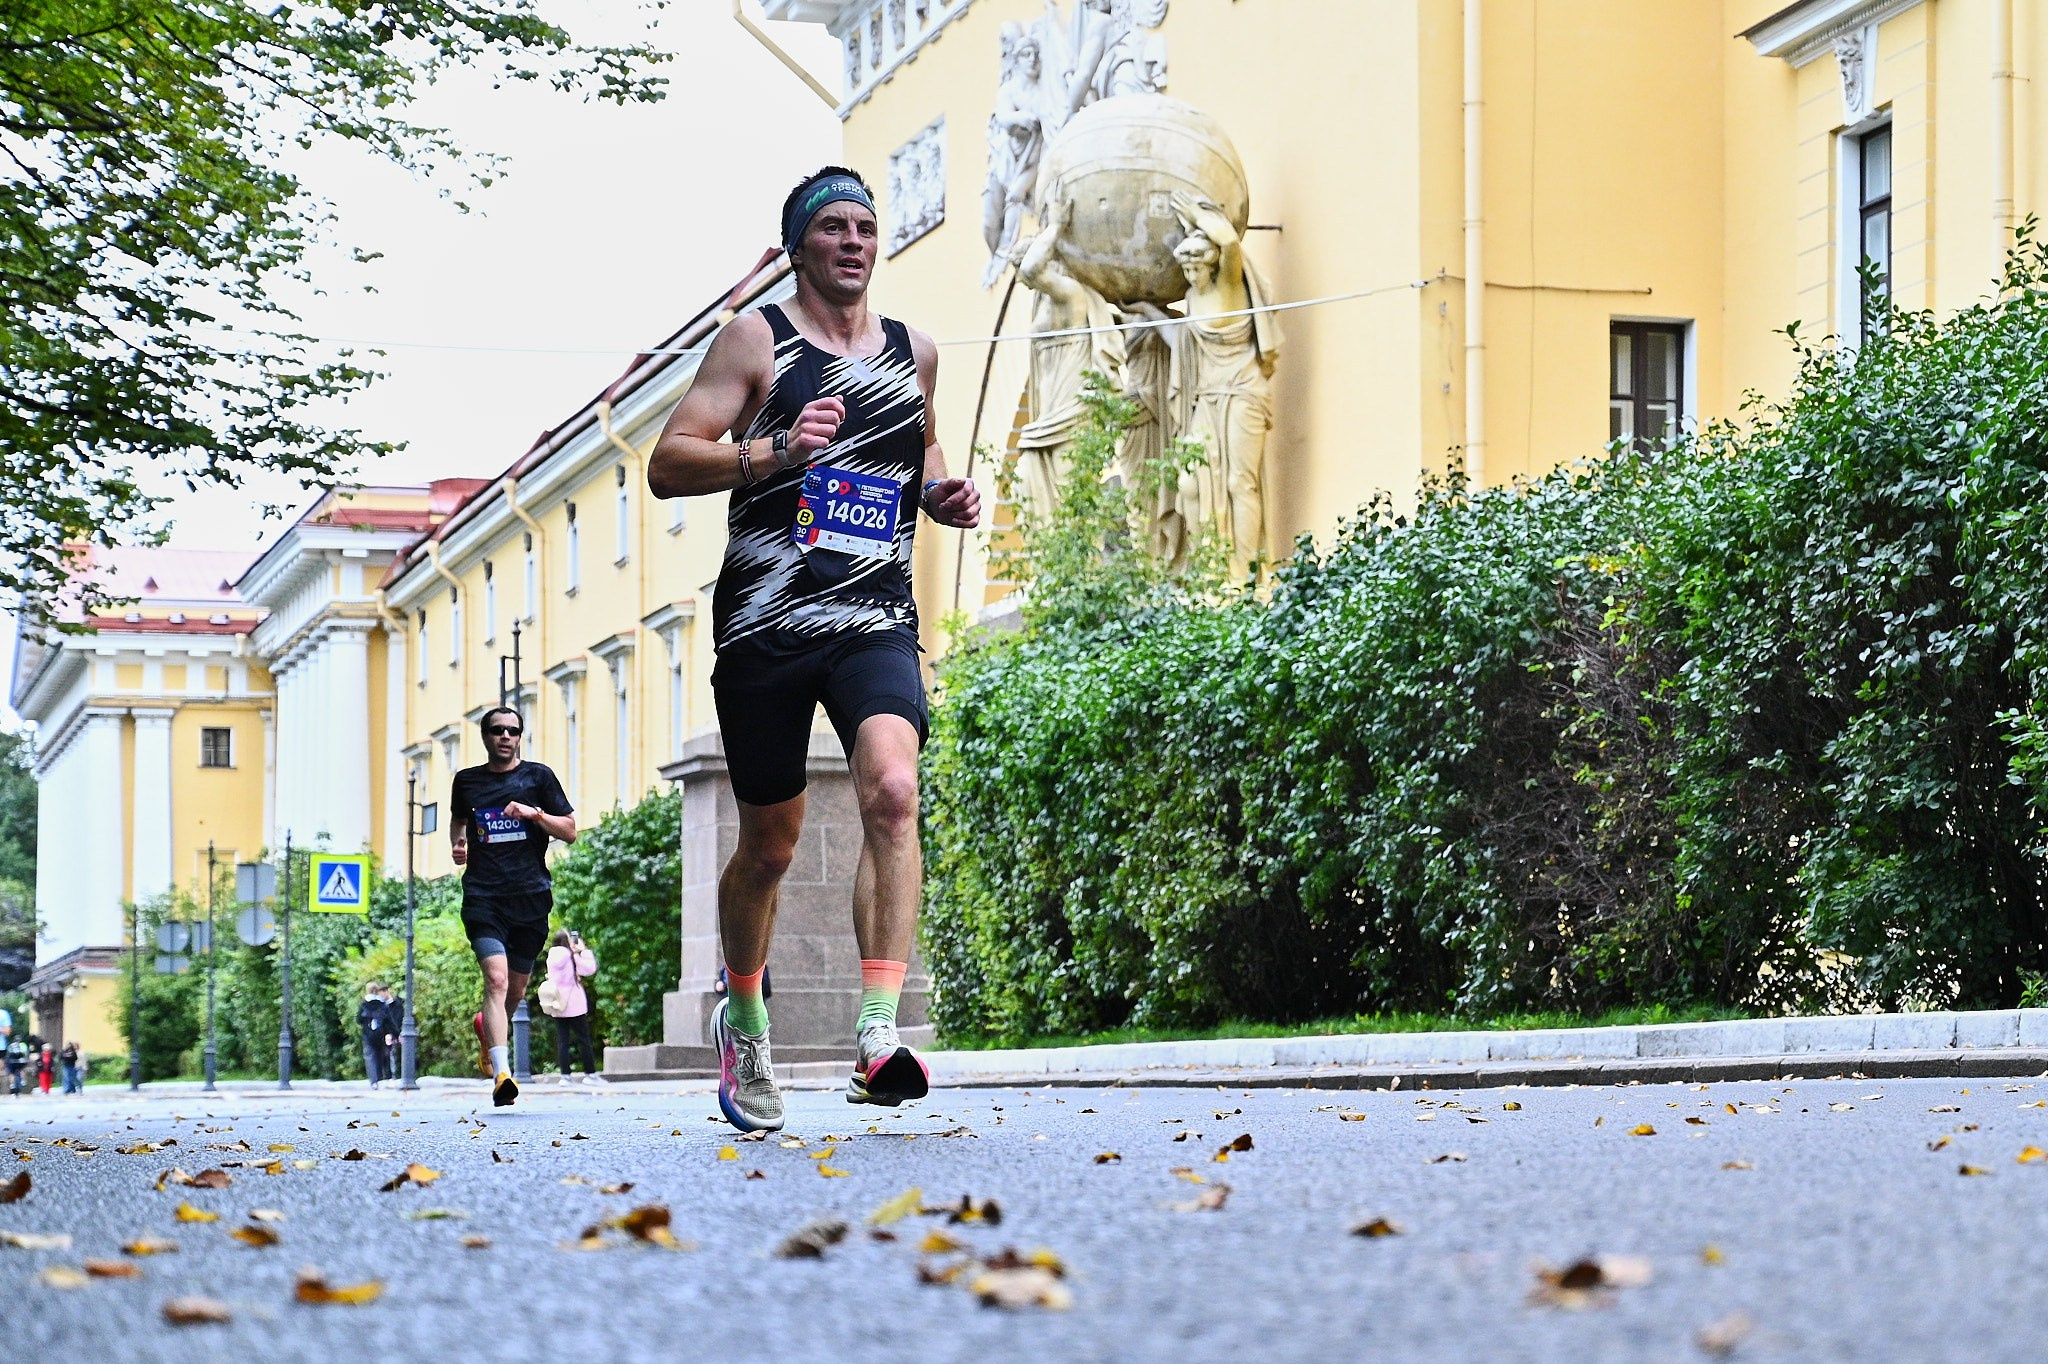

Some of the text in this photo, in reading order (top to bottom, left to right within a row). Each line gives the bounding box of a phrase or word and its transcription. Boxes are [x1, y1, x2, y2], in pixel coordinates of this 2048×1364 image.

[827, 478, 851, 496] 99
[826, 499, 887, 530] 14026
[796, 526, 807, 535] 30
[487, 820, 519, 831] 14200
